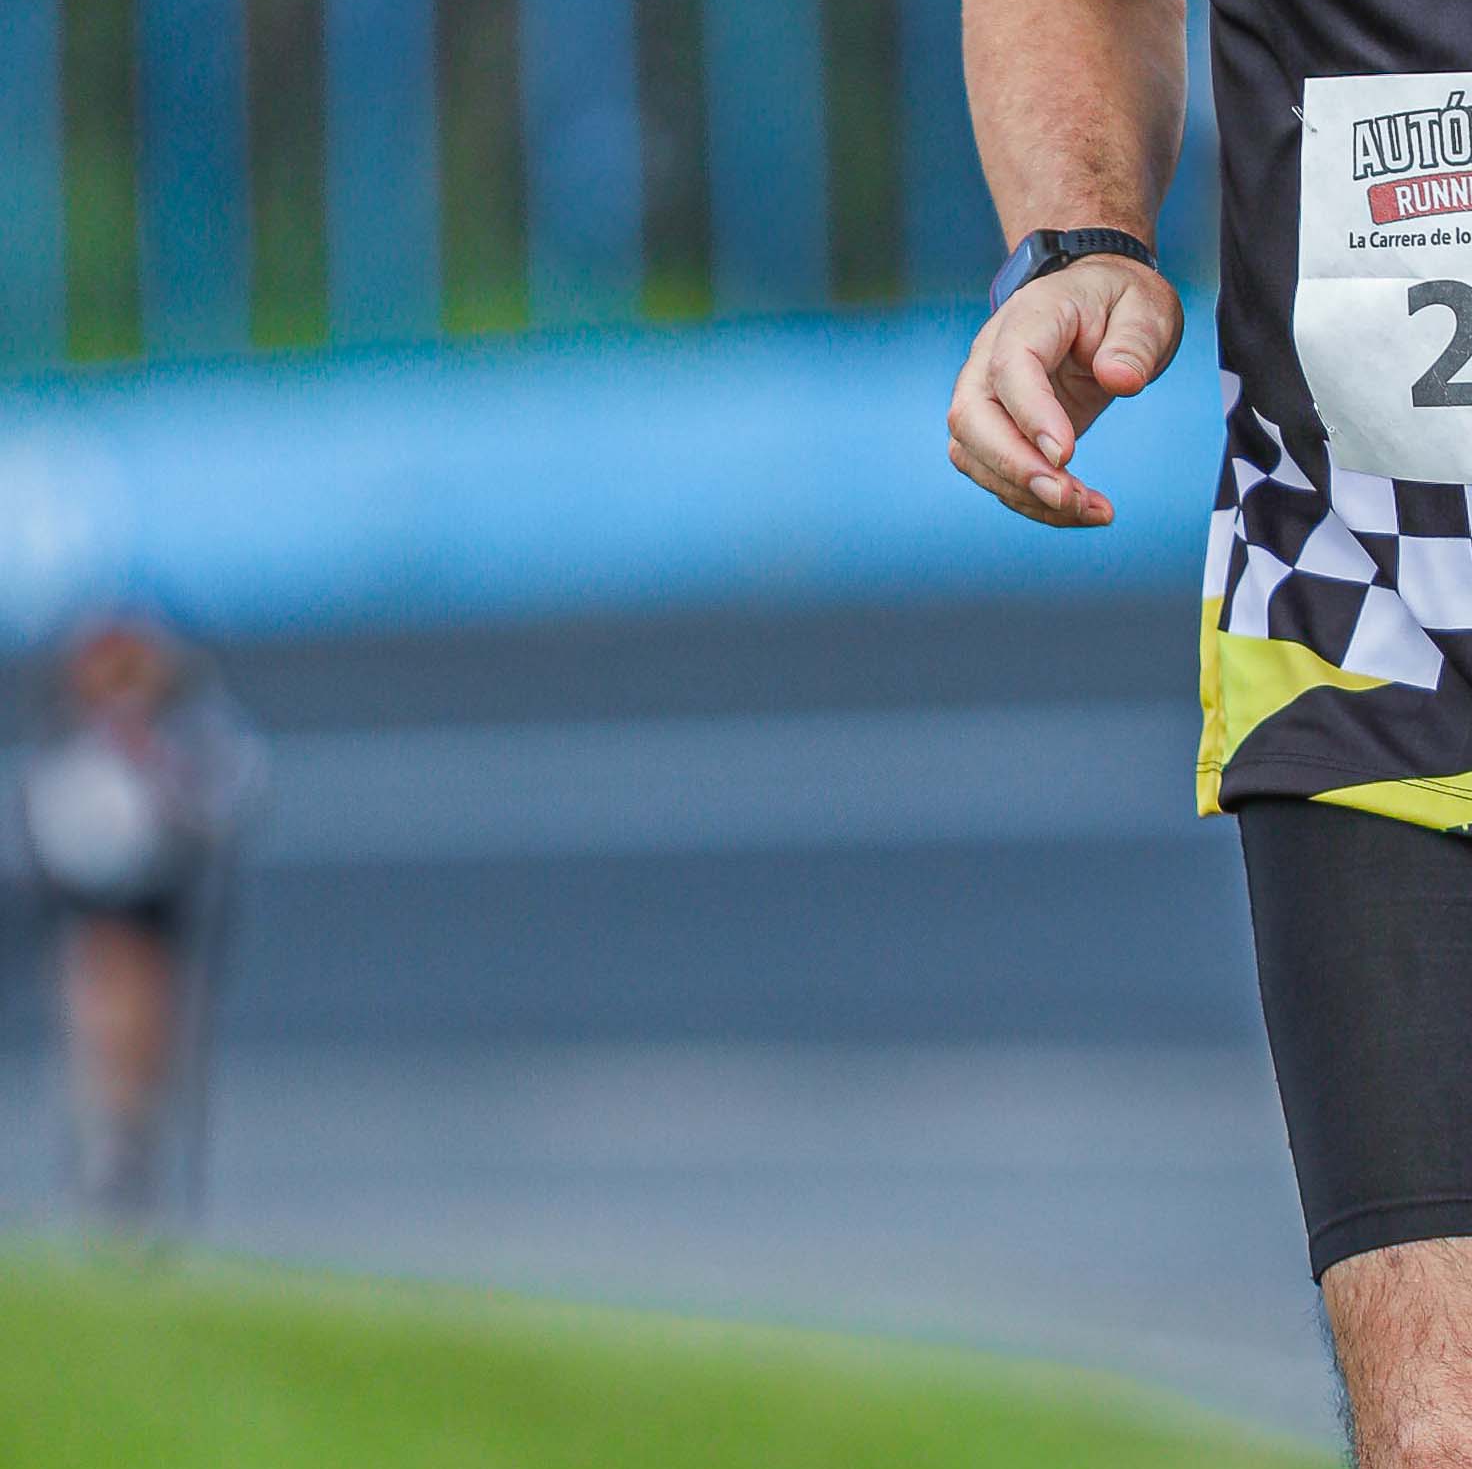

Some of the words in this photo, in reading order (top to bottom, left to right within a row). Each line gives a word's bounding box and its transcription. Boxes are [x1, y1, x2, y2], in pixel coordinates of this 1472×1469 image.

[1349, 231, 1366, 249] La
[1370, 231, 1426, 248] Carrera
[1432, 228, 1450, 245] de
